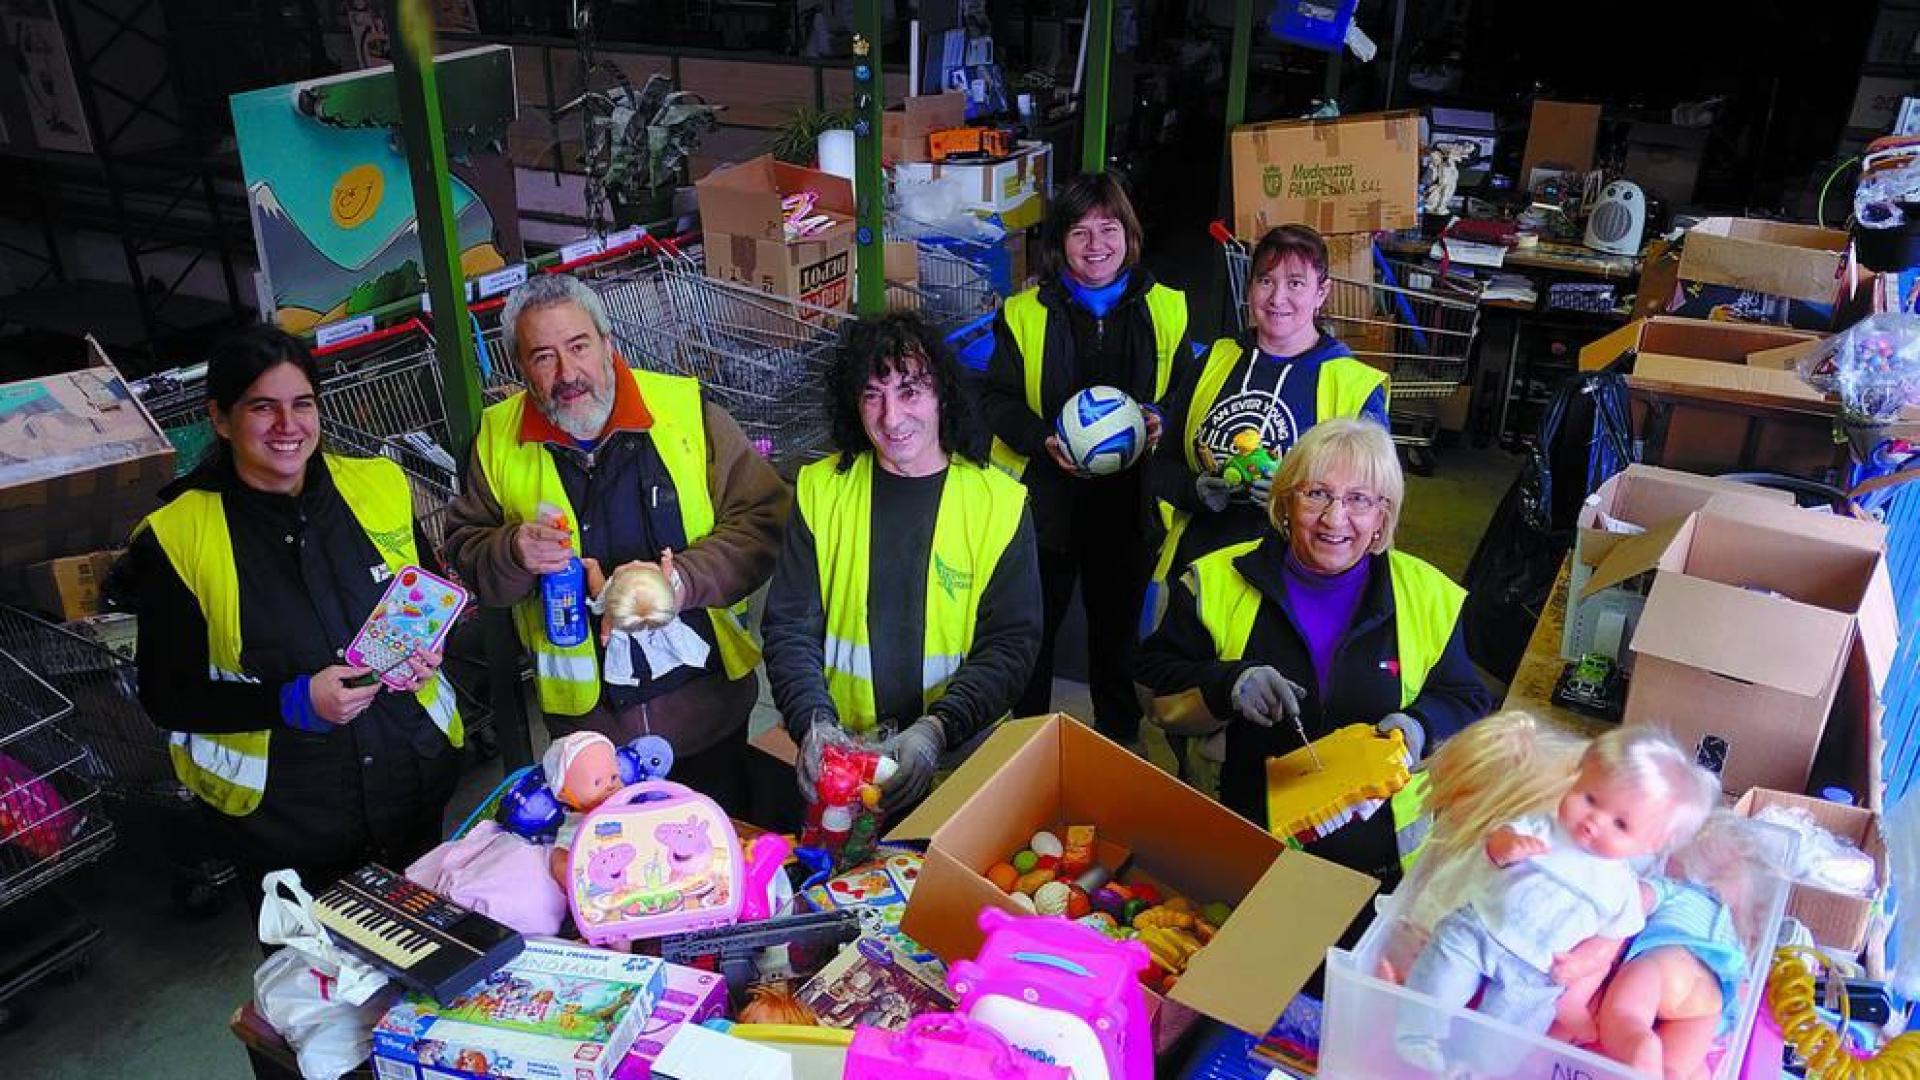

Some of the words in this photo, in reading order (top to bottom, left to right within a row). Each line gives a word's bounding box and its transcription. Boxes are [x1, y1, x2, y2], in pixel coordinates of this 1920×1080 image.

[1291, 163, 1353, 180] Mudanzas
[1288, 178, 1355, 198] PAMPLONA
[1231, 398, 1263, 413] EVER
